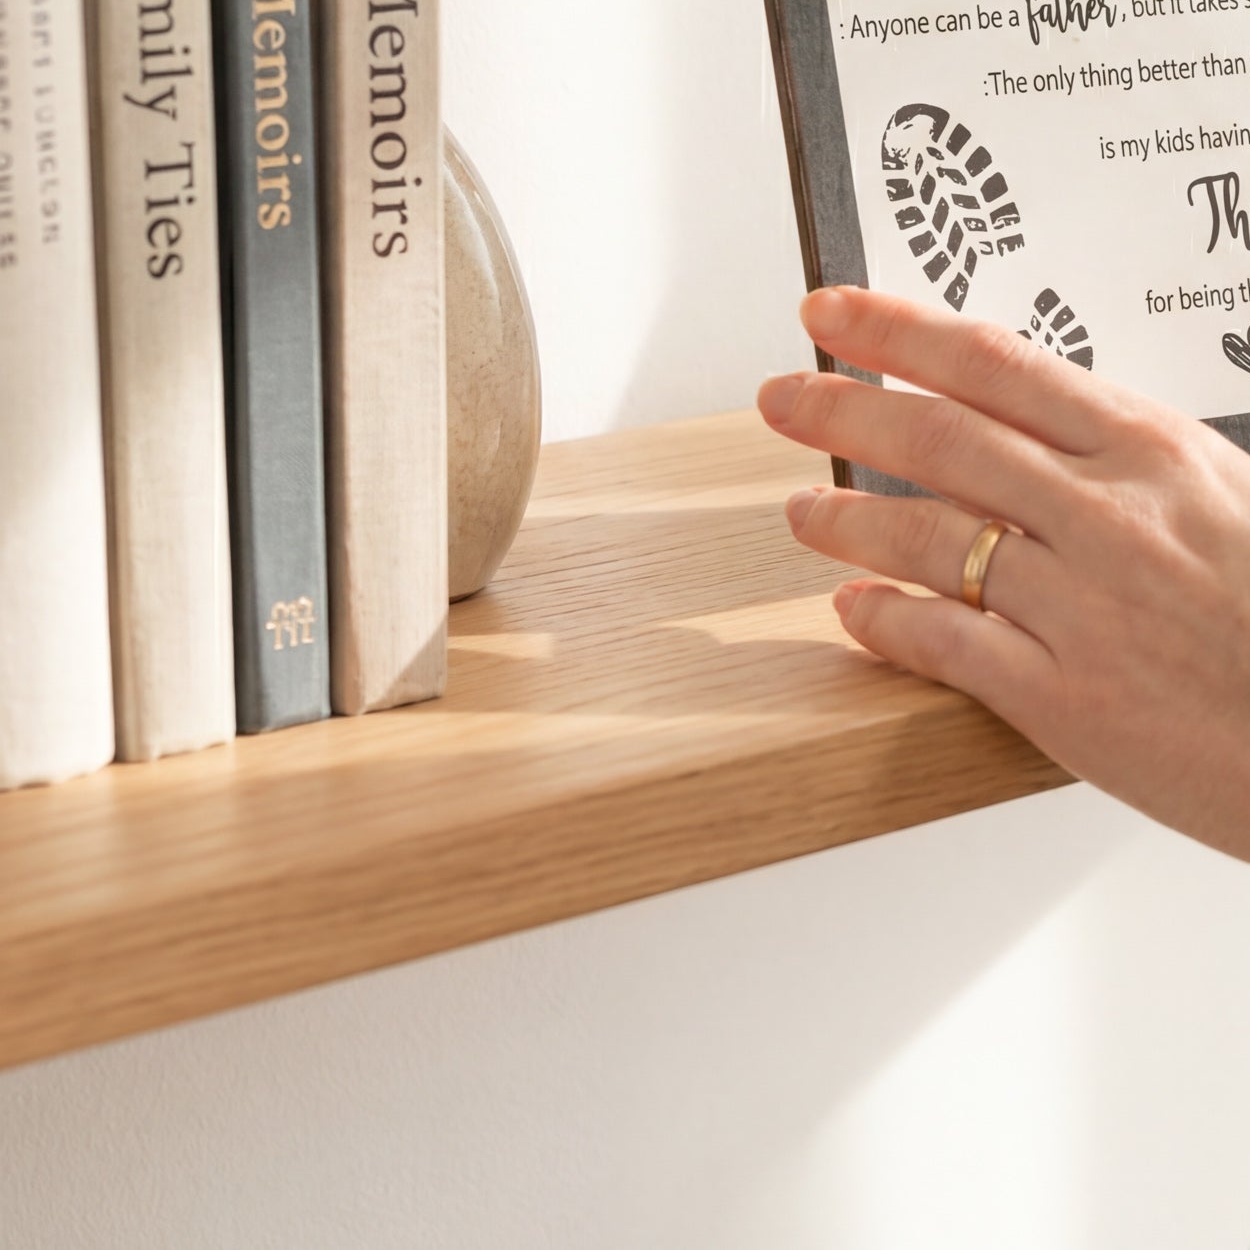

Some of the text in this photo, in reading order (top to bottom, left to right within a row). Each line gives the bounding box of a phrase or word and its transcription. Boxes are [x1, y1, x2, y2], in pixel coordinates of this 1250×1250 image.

[850, 13, 930, 44] Anyone
[935, 13, 972, 33] can
[976, 4, 1003, 30] be
[1008, 9, 1021, 27] a
[1033, 64, 1076, 96] only
[1079, 61, 1134, 92] thing
[1137, 56, 1199, 84] better
[1201, 52, 1248, 79] than
[1099, 136, 1116, 160] is
[1120, 137, 1150, 162] my
[1154, 126, 1195, 155] kids
[144, 141, 195, 281] Ties
[1145, 288, 1174, 315] for
[1178, 280, 1235, 312] being
